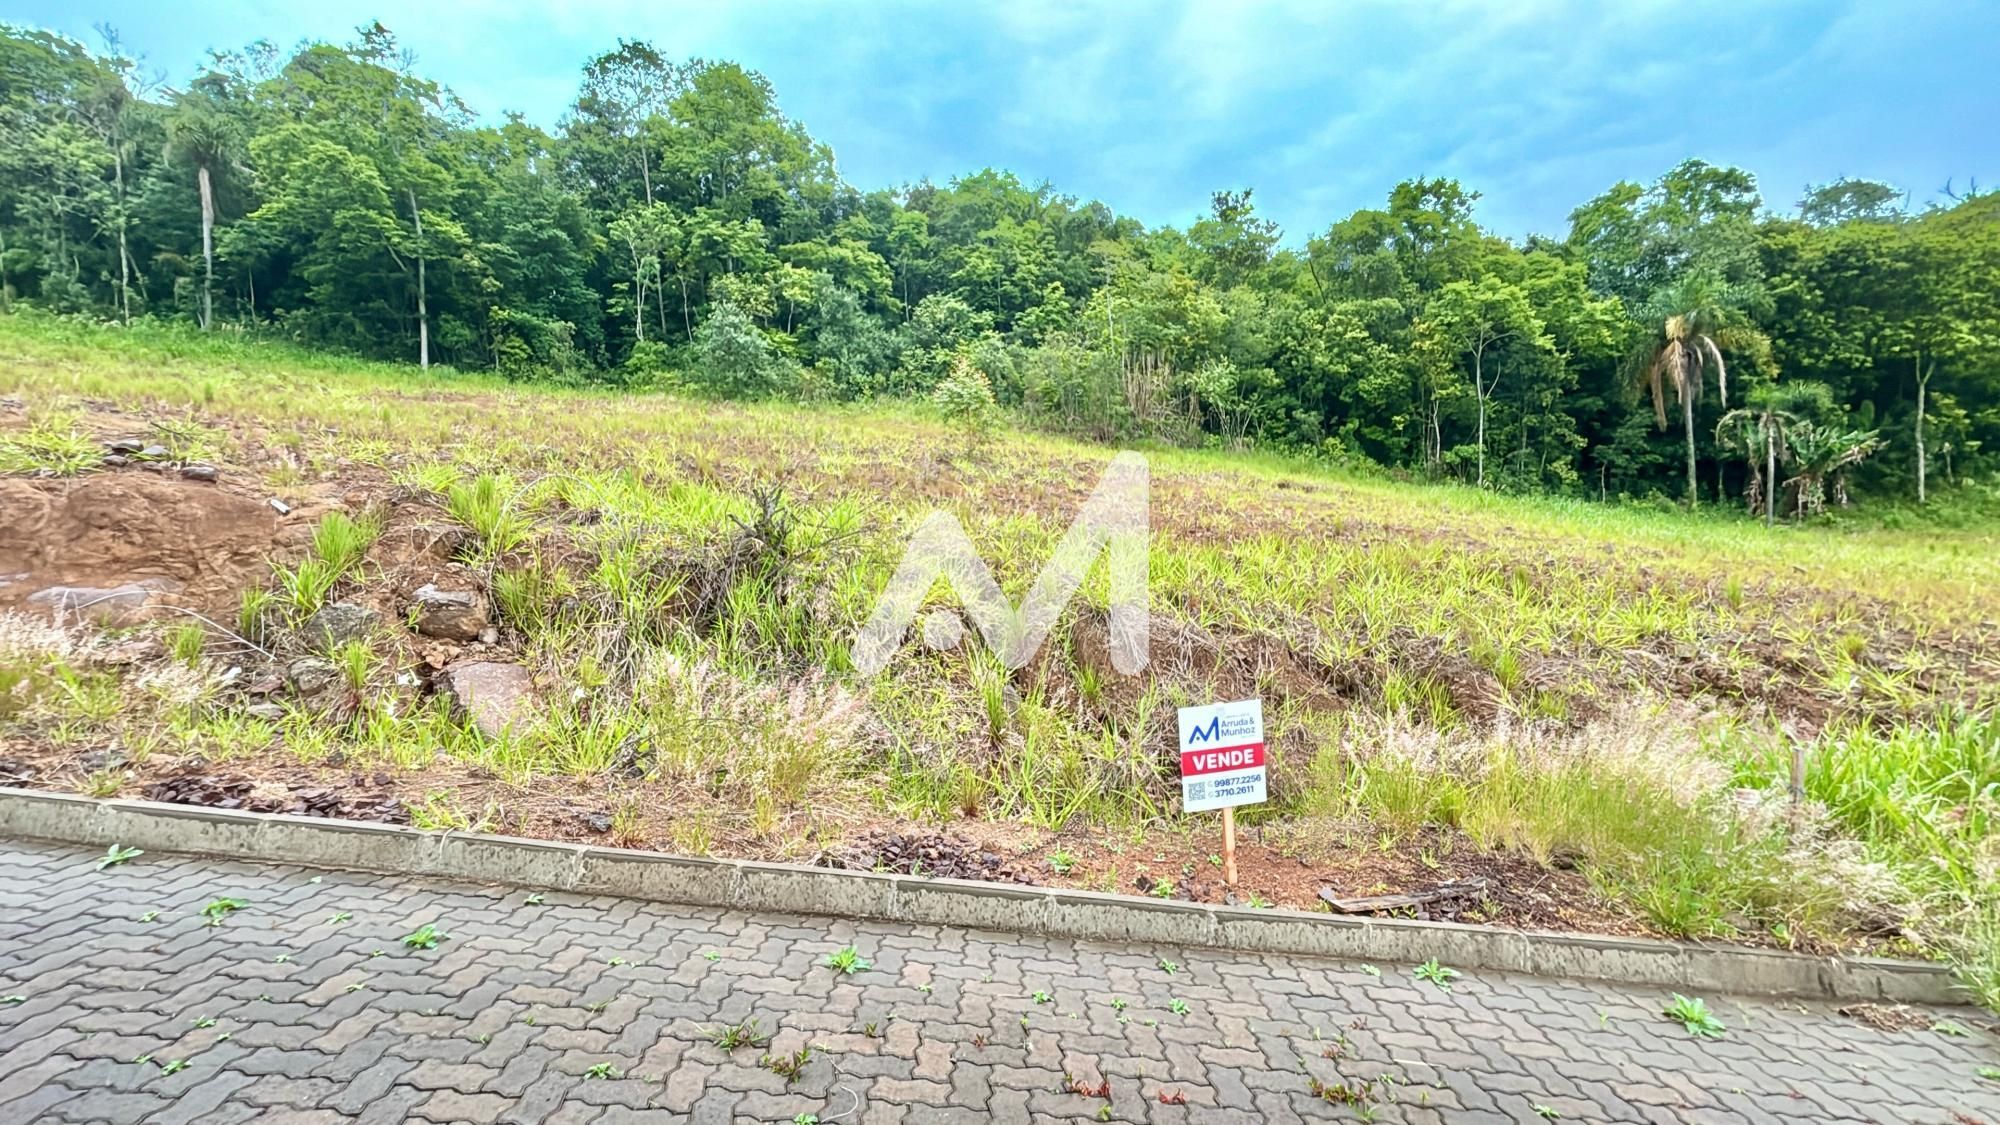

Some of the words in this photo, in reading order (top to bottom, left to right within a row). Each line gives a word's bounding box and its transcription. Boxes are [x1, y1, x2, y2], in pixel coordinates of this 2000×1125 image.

[1221, 718, 1248, 728] Arruda
[1249, 717, 1255, 725] &
[1221, 726, 1256, 737] Munhoz
[1192, 748, 1255, 771] VENDE
[1214, 774, 1261, 788] 99877.2256
